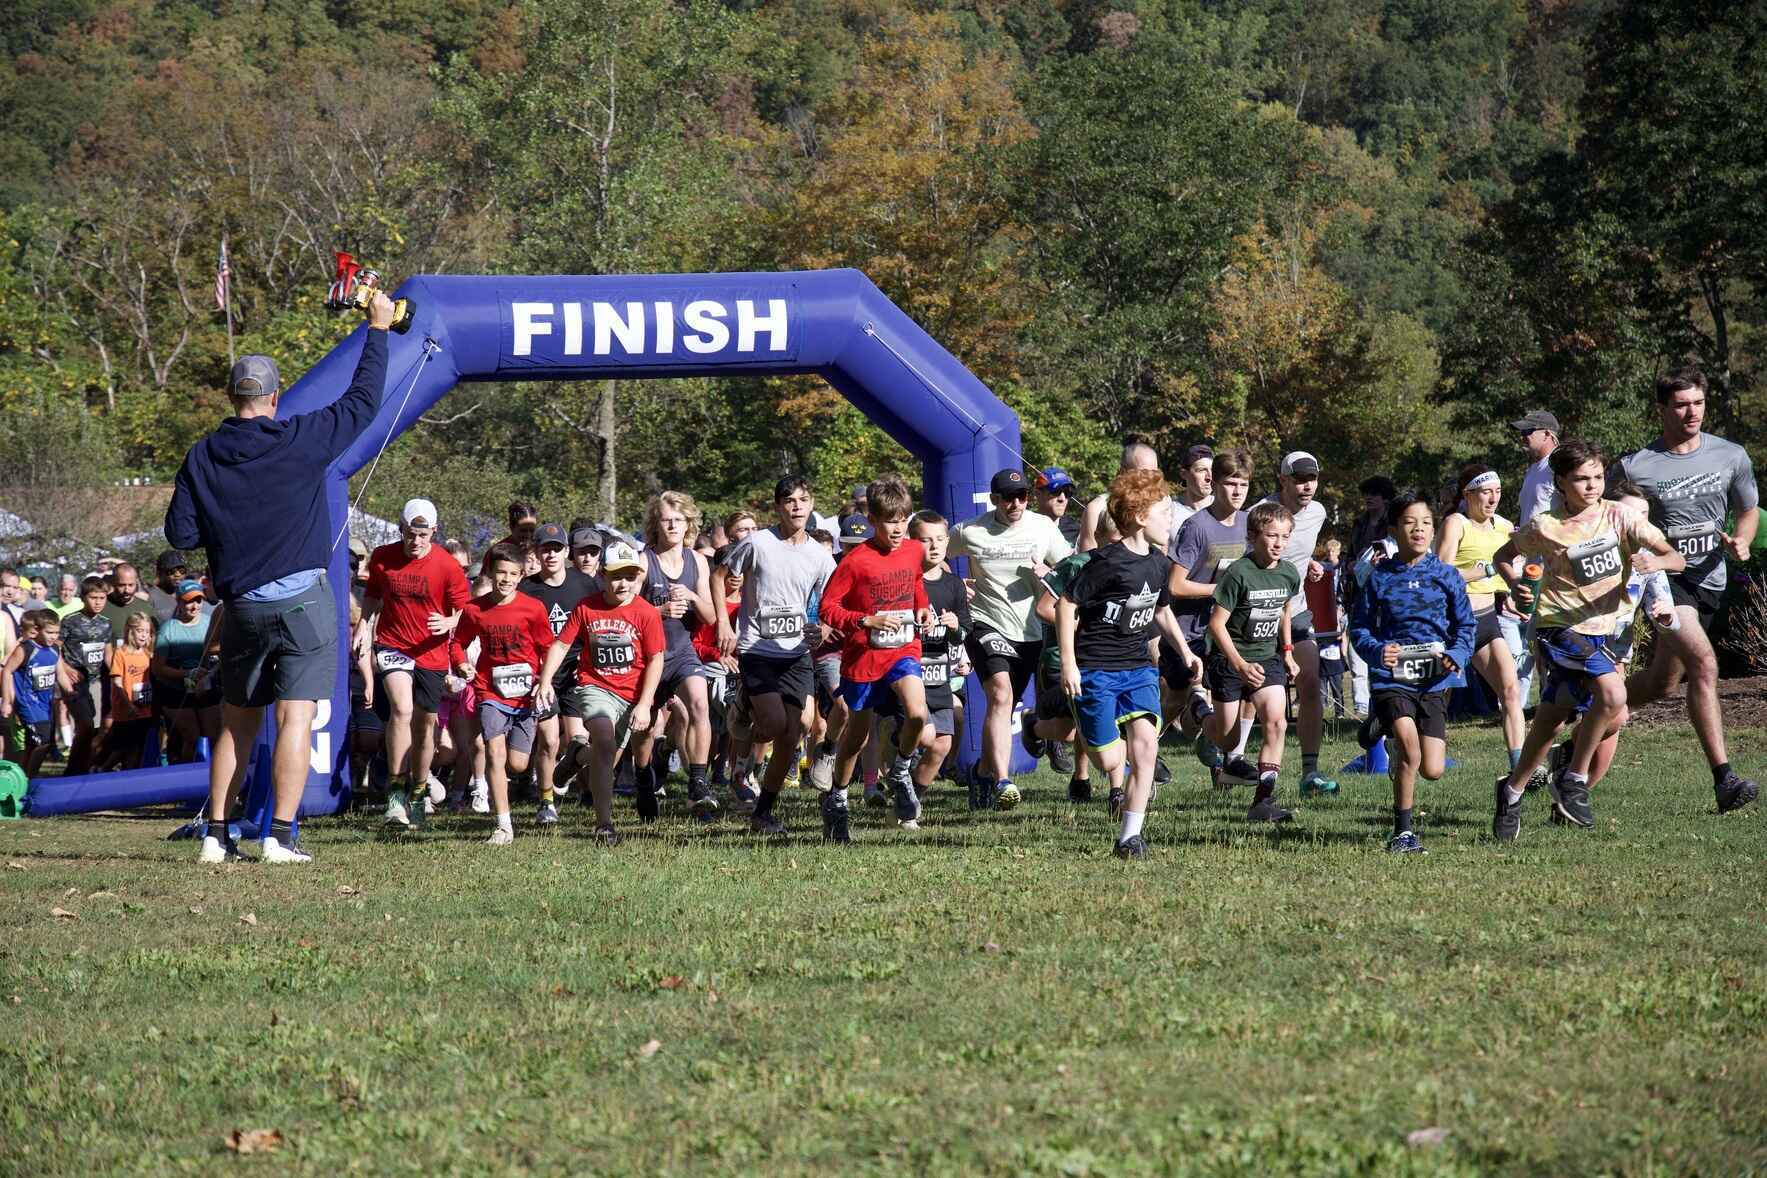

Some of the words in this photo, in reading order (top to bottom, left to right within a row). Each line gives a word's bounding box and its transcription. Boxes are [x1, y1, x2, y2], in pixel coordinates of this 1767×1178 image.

[512, 299, 788, 355] FINISH
[1678, 536, 1706, 556] 501
[1581, 551, 1615, 577] 568
[769, 616, 795, 634] 526
[1129, 608, 1153, 629] 649
[1253, 621, 1275, 638] 592
[597, 646, 625, 664] 516
[1403, 659, 1434, 680] 657
